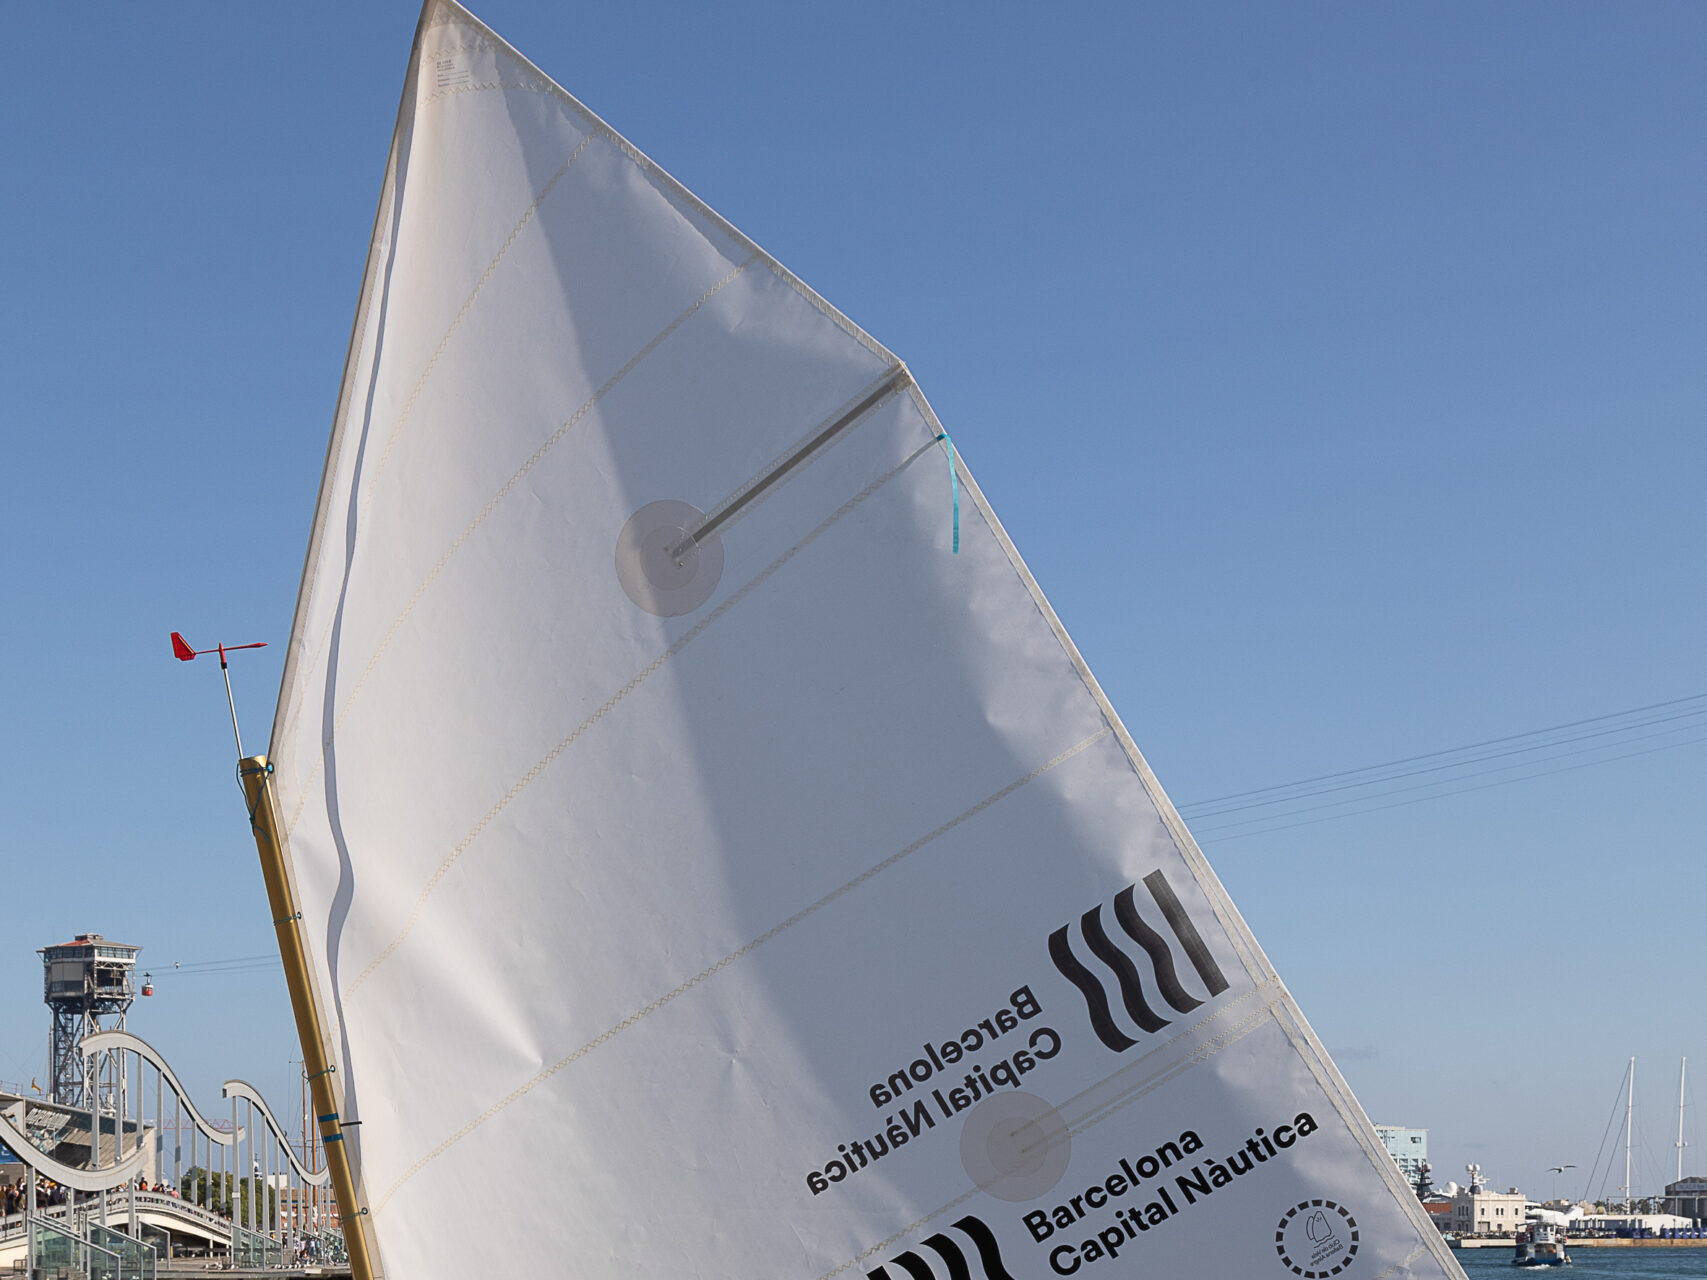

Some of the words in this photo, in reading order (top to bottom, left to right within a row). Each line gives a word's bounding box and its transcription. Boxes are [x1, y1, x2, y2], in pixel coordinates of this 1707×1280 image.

[1022, 1130, 1204, 1244] Barcelona
[1049, 1186, 1179, 1276] Capital
[1174, 1112, 1319, 1205] Nàutica
